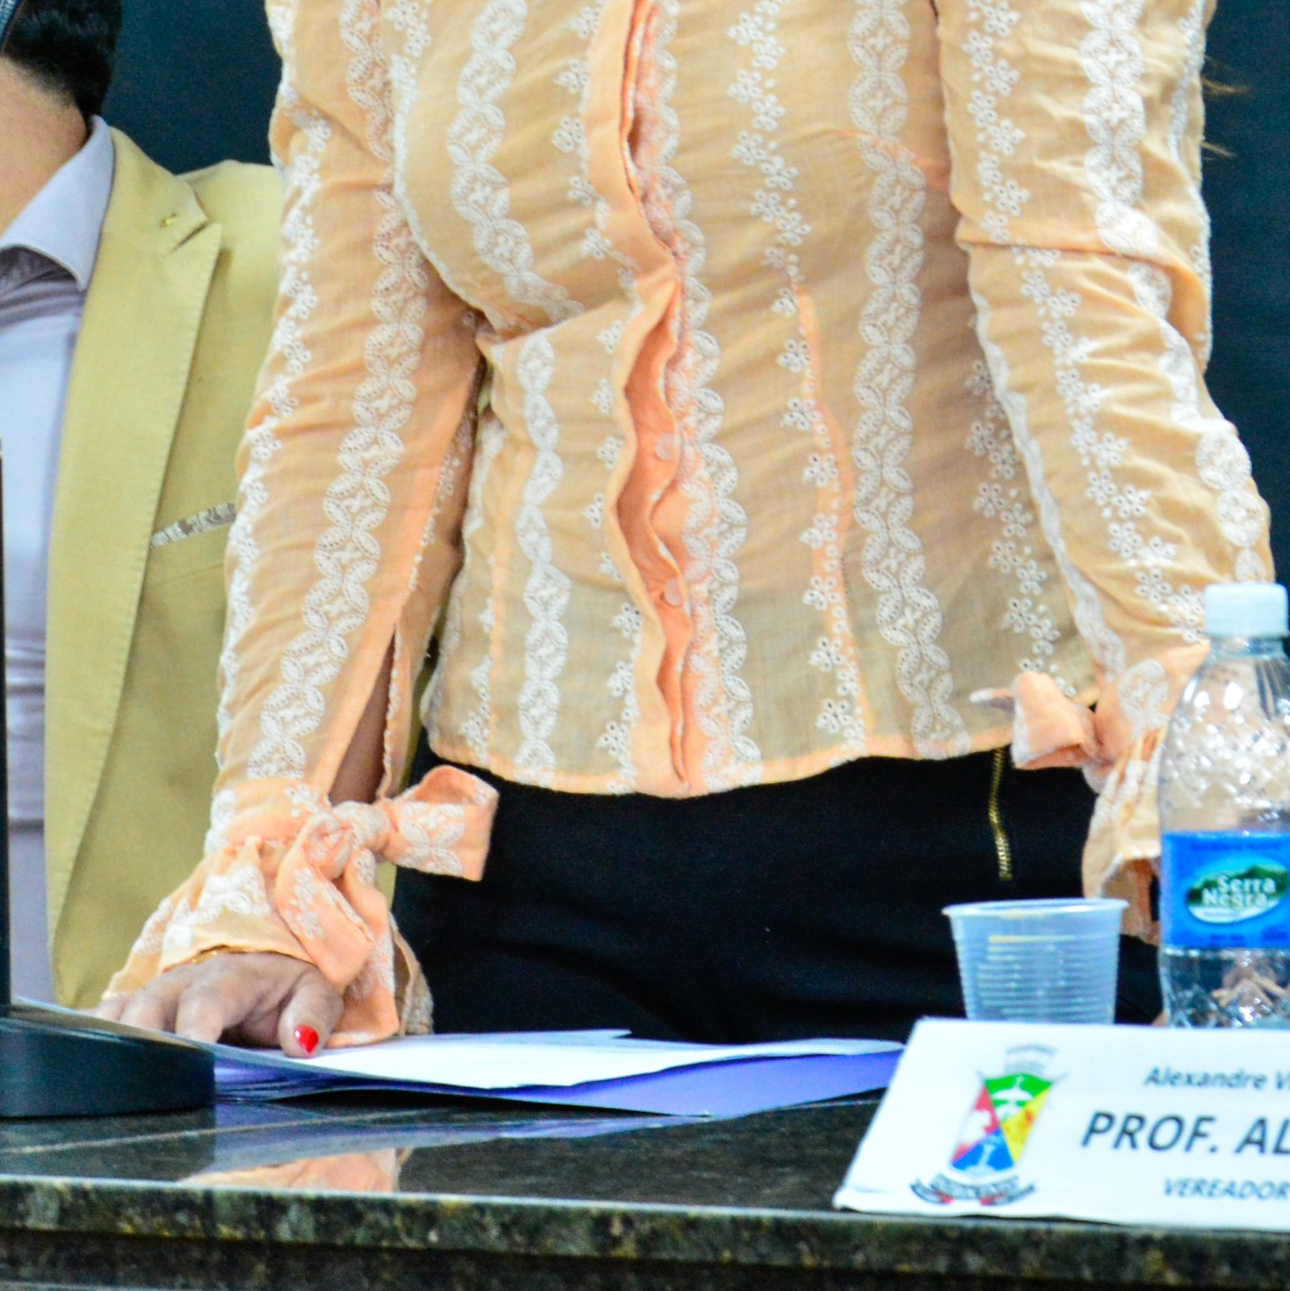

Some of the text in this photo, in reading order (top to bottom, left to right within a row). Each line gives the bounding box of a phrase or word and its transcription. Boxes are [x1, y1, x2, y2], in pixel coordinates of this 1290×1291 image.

[1217, 875, 1277, 893] Serra
[1202, 888, 1269, 911] Negra
[1143, 1067, 1267, 1090] Alexandre
[1081, 1109, 1218, 1153] PROF.
